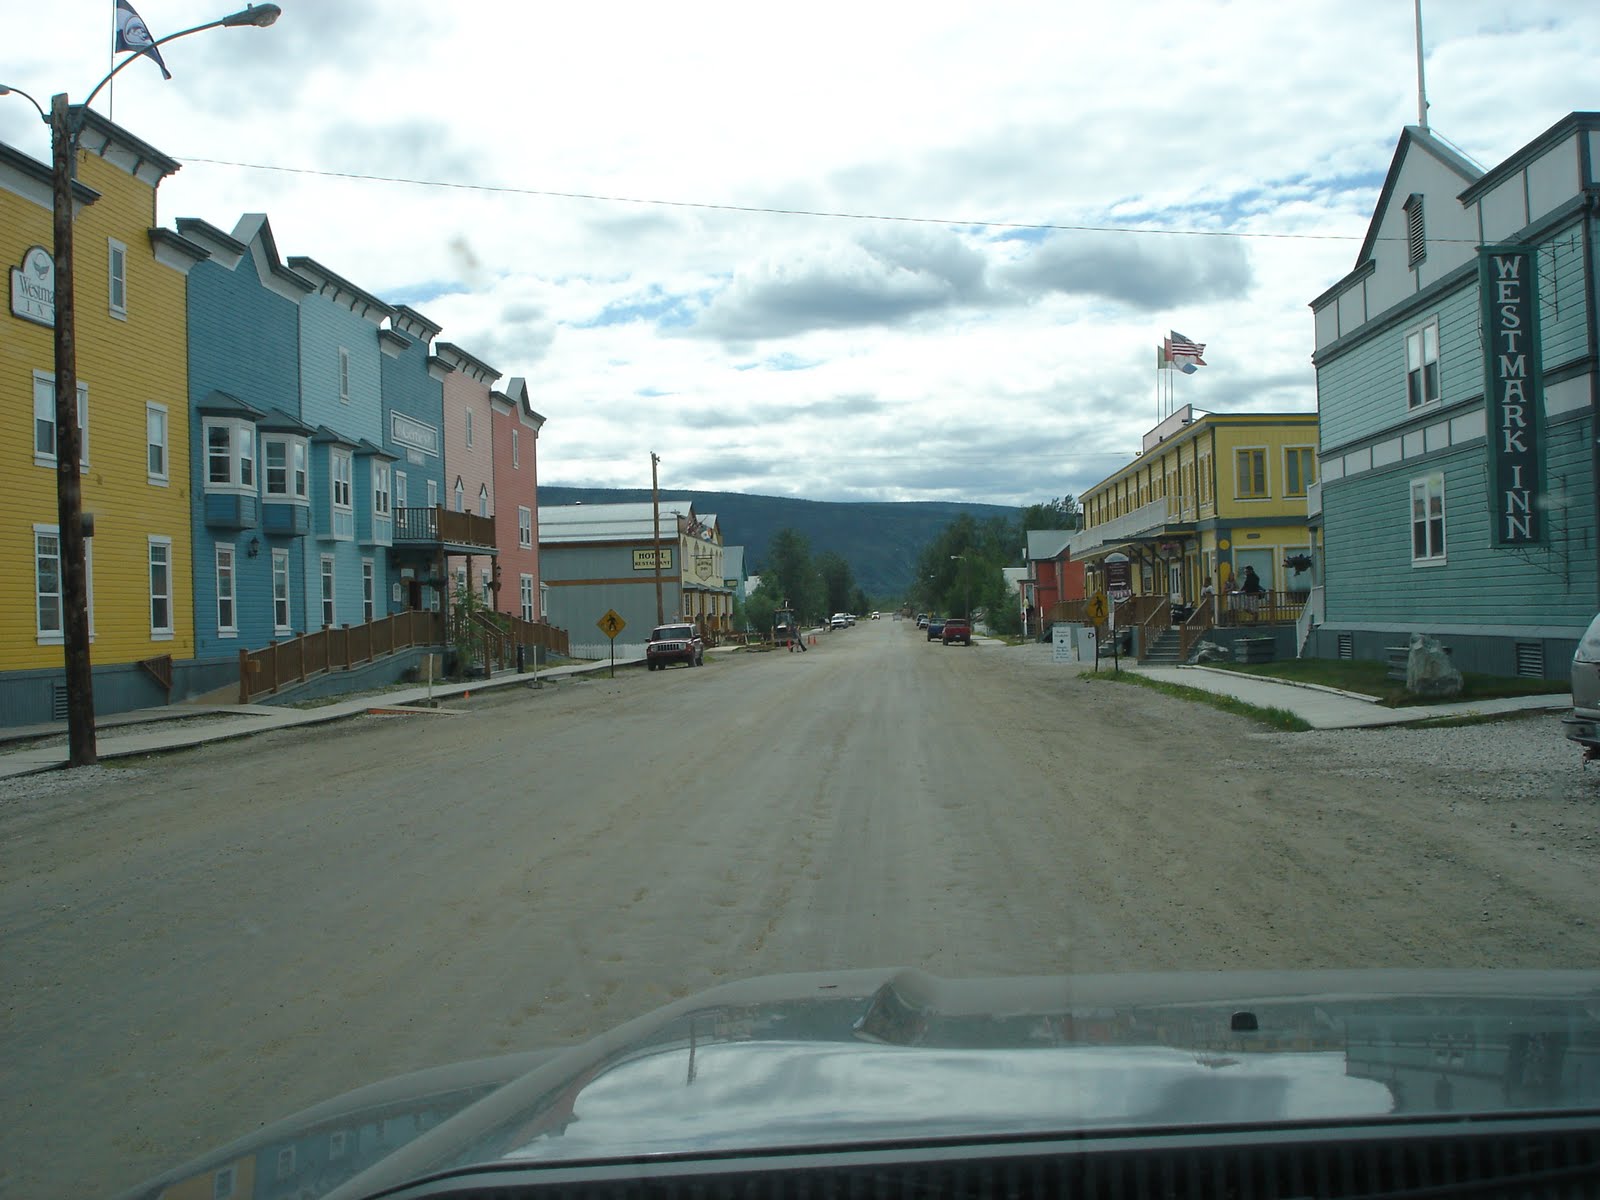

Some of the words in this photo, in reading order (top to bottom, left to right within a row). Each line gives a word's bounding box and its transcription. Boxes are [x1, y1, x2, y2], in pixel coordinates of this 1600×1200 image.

[19, 274, 54, 303] Westma
[1493, 255, 1527, 453] WESTMARK
[1505, 465, 1531, 539] INN
